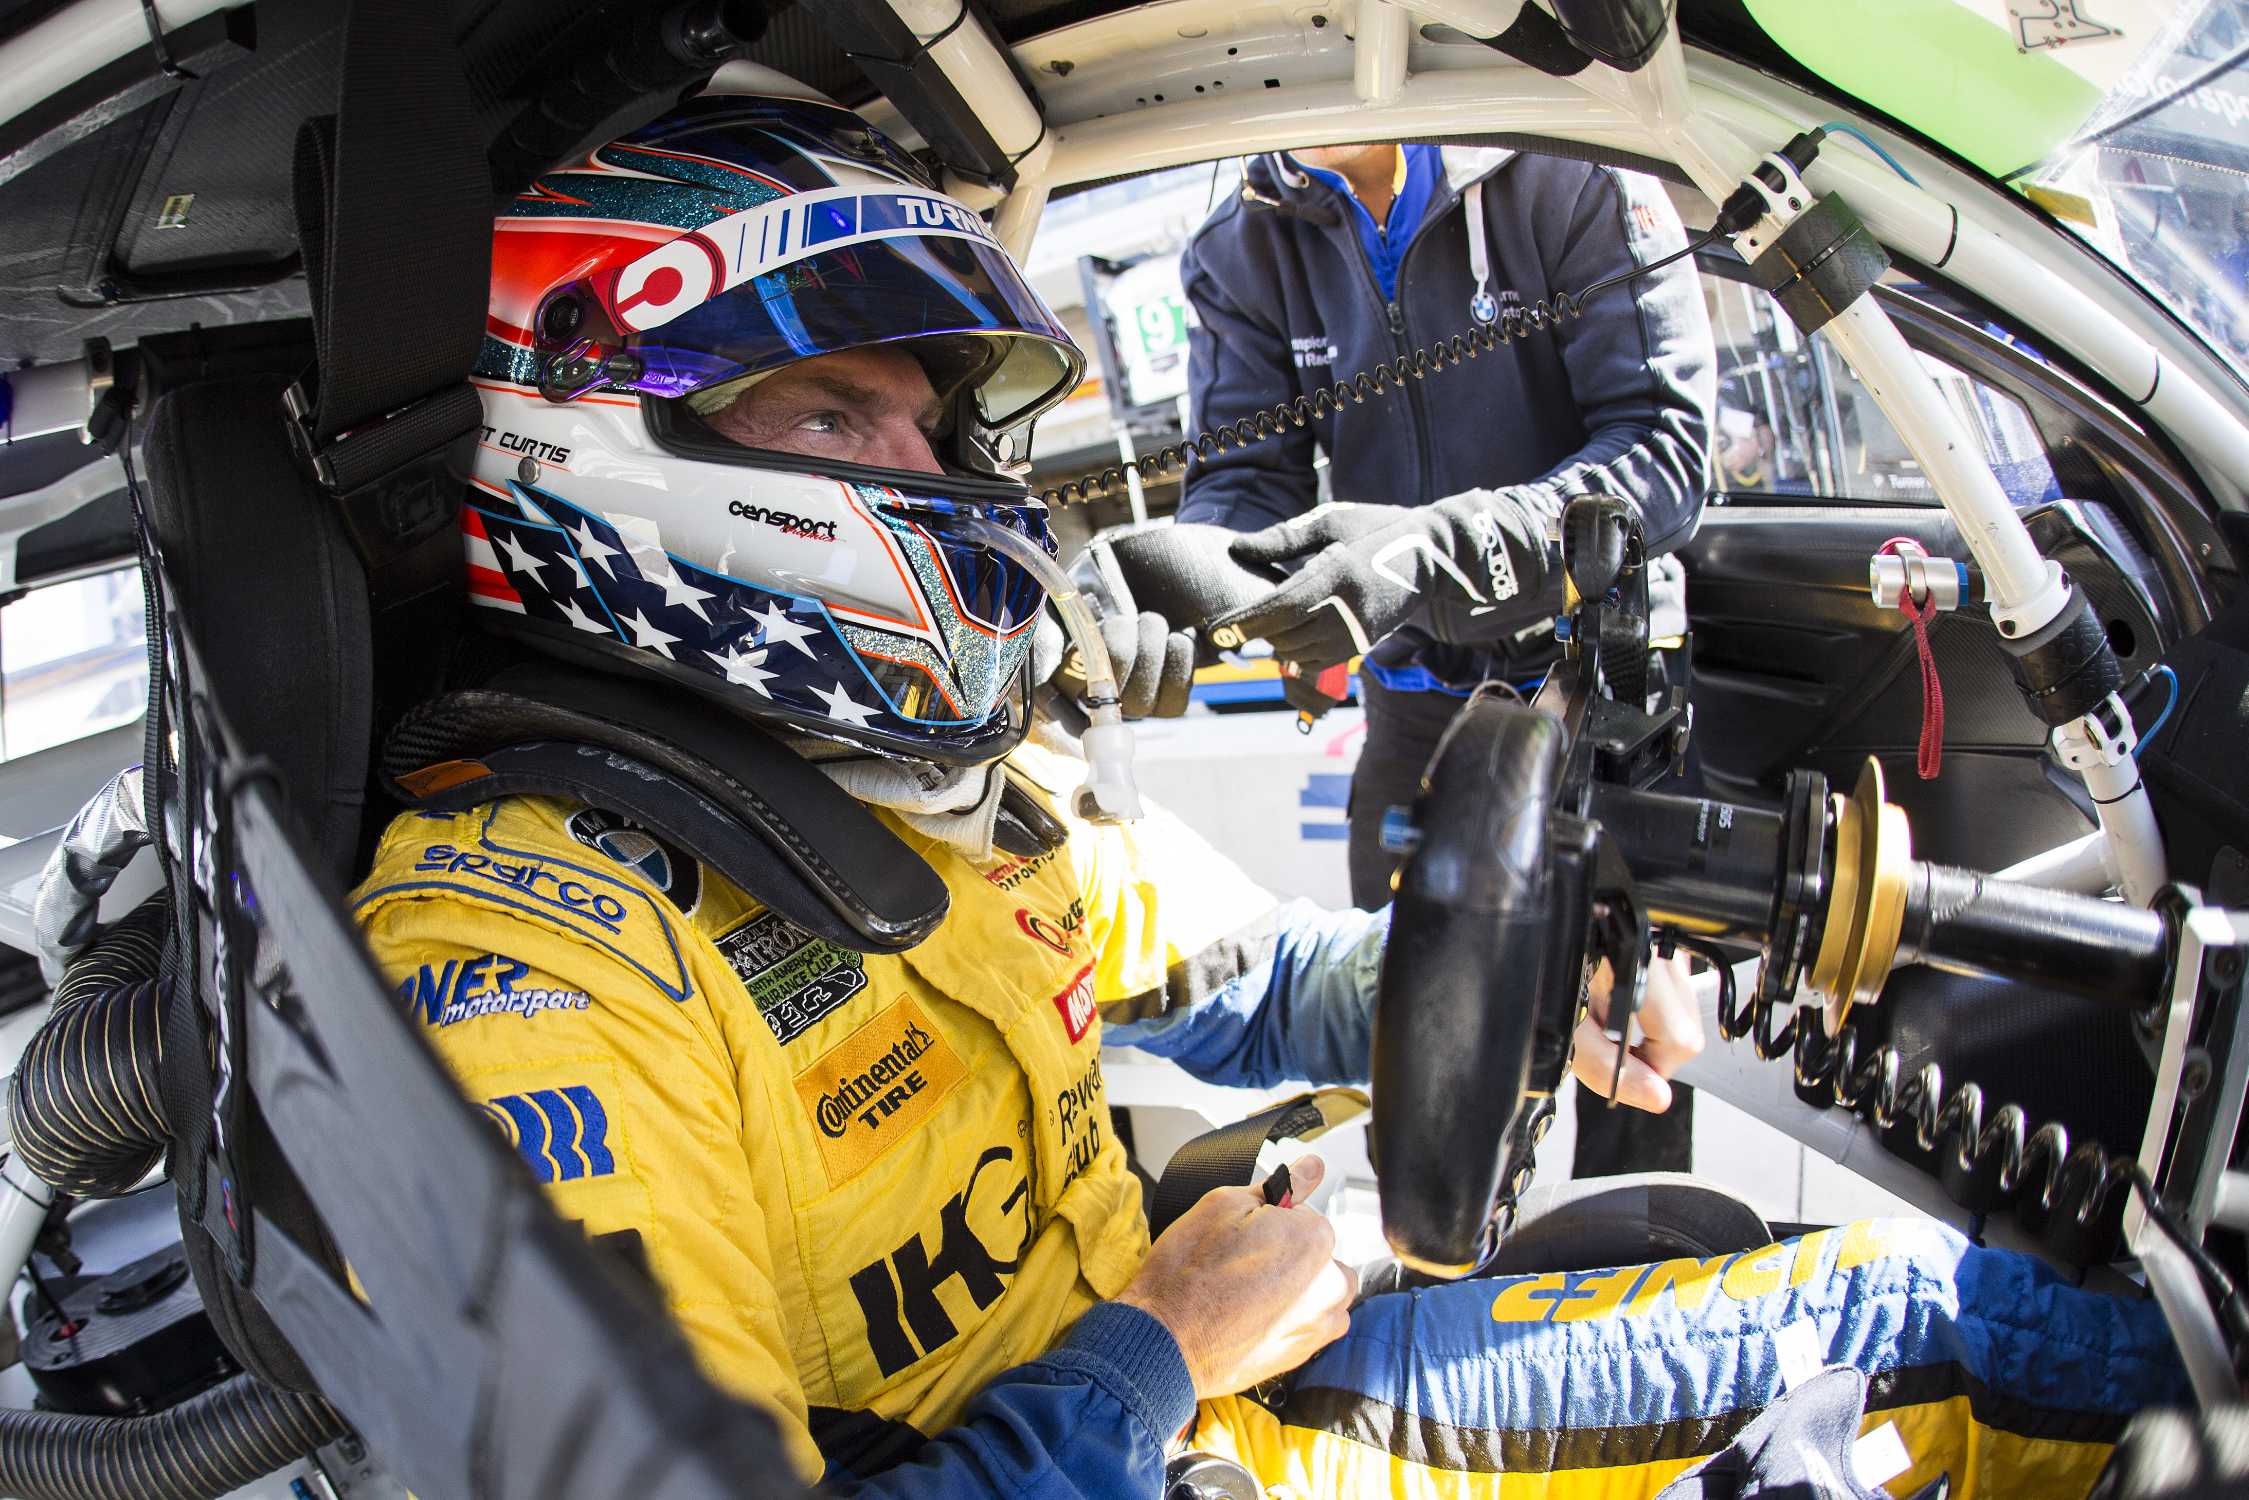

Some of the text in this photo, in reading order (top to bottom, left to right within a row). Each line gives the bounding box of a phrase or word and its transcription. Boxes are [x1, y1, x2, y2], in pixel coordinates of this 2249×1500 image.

[499, 432, 571, 463] CURTIS
[415, 844, 627, 935] sparco
[729, 923, 772, 951] TEQUILA
[397, 953, 530, 1025] NER
[440, 989, 592, 1028] motorsport
[816, 1024, 935, 1138] Continental
[857, 1070, 928, 1130] TIRE
[849, 1145, 1032, 1379] IHG
